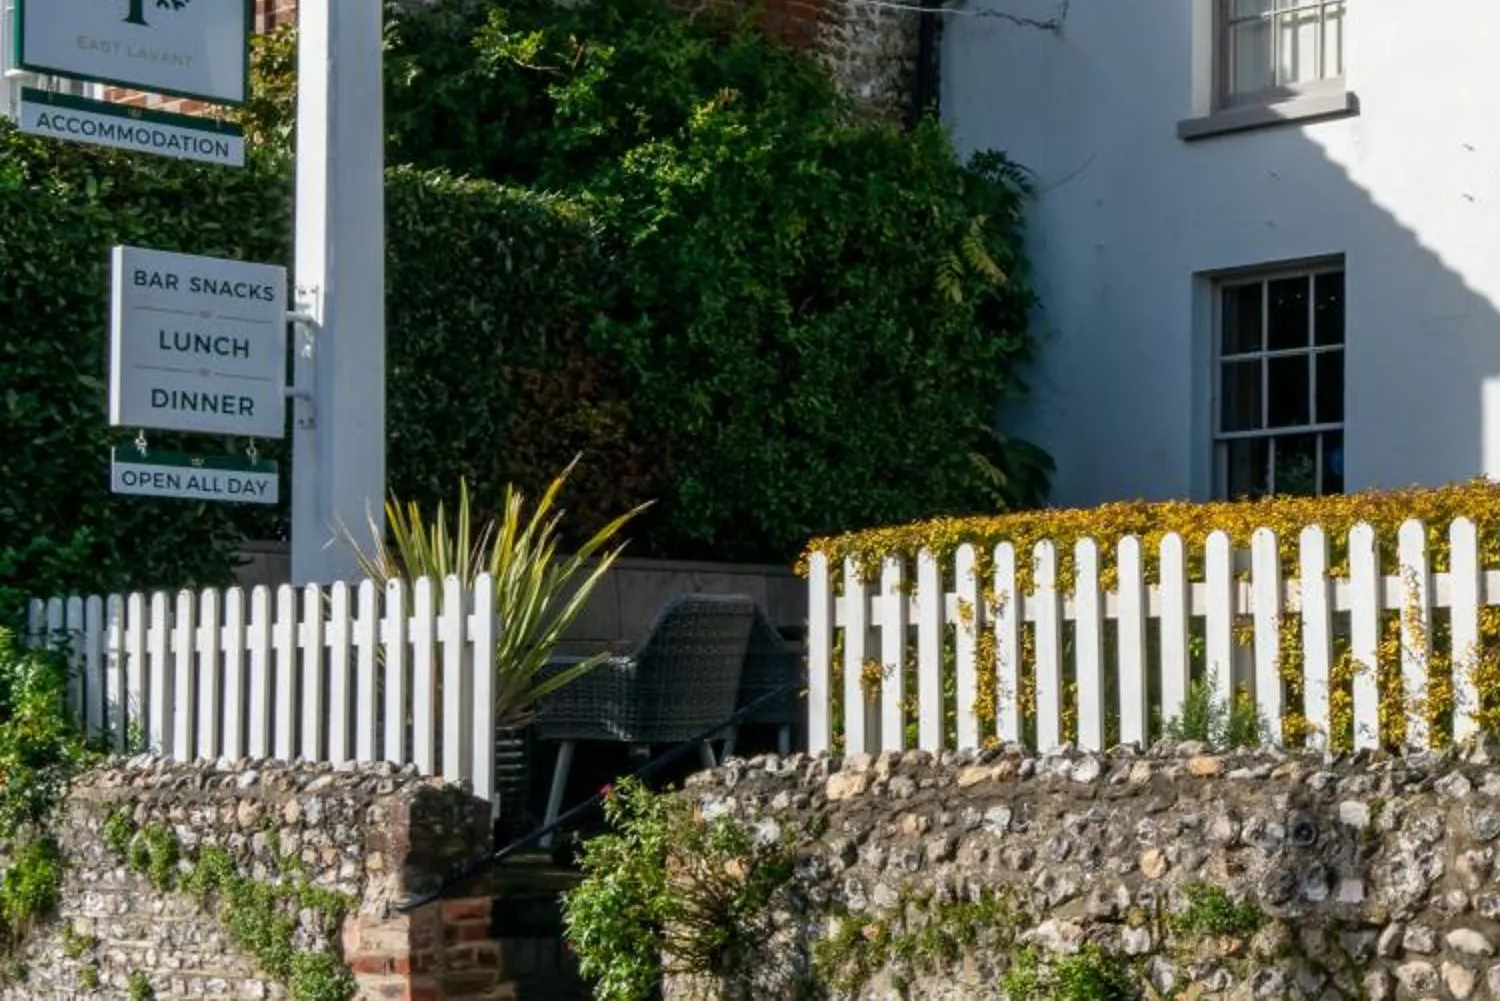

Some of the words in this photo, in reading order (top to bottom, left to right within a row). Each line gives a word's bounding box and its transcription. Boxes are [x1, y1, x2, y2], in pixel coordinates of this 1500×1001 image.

[36, 111, 230, 158] ACCOMMODATION
[133, 269, 179, 291] BAR
[189, 276, 275, 302] SNACKS
[159, 329, 250, 359] LUNCH
[151, 388, 255, 416] DINNER
[121, 470, 182, 490] OPEN
[185, 475, 222, 493] ALL
[228, 478, 269, 496] DAY
